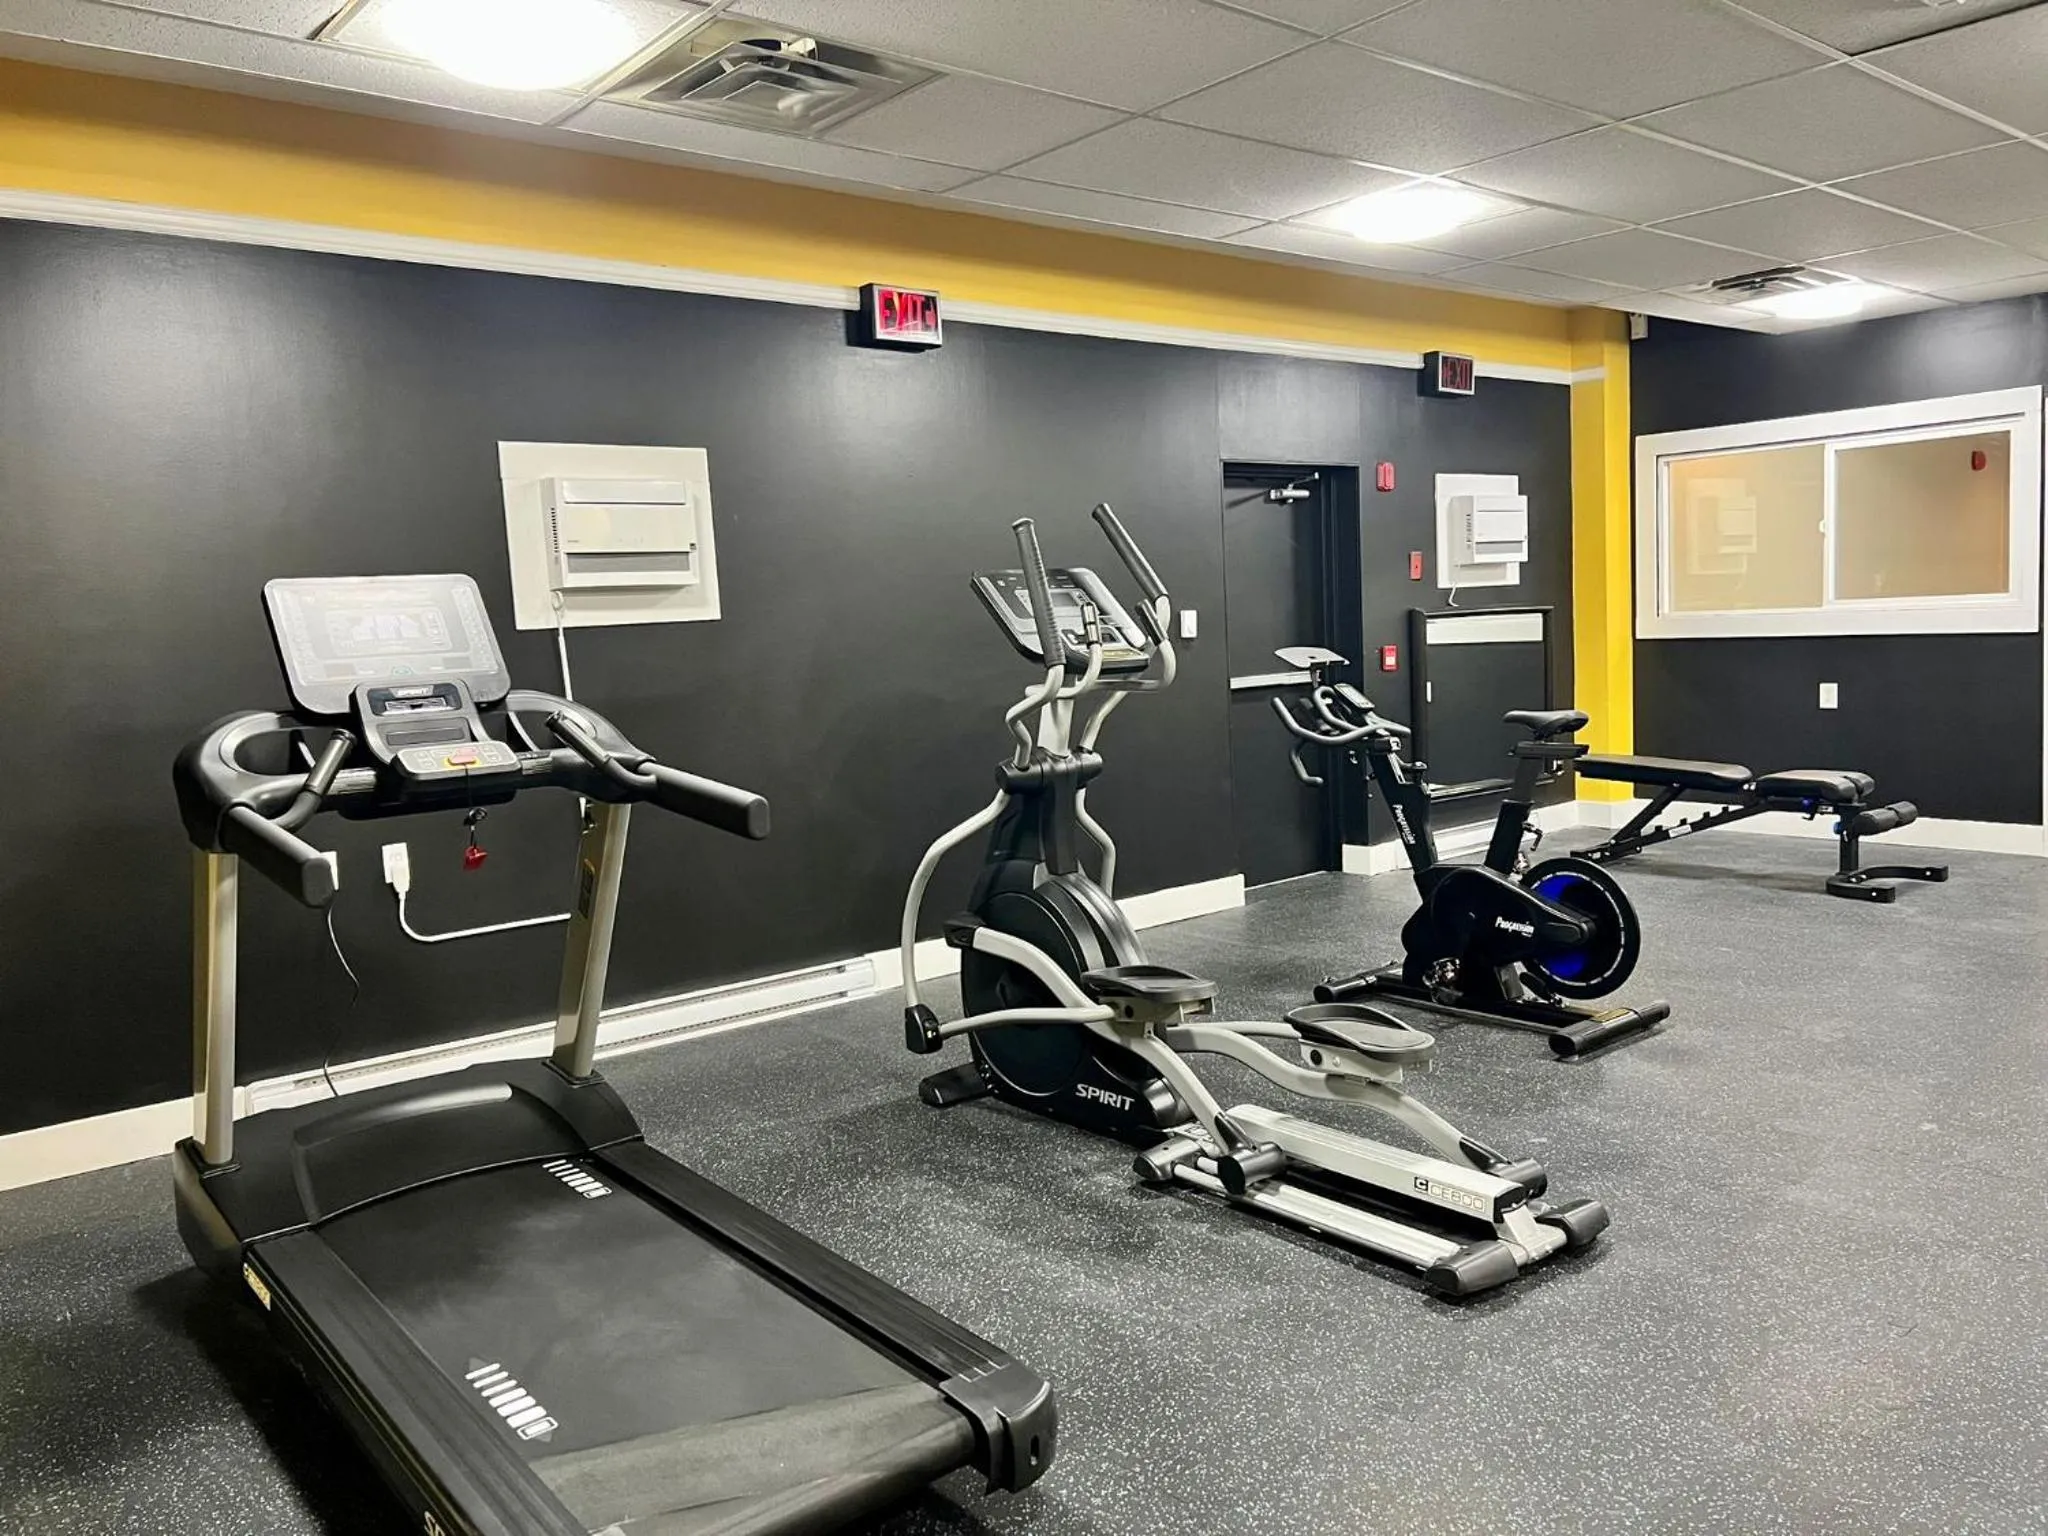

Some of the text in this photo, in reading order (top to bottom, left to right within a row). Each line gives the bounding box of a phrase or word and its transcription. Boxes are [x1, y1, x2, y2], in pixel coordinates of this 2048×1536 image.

[879, 288, 925, 334] EXIT
[1447, 357, 1472, 390] EXIT
[1075, 1083, 1135, 1111] SPIRIT
